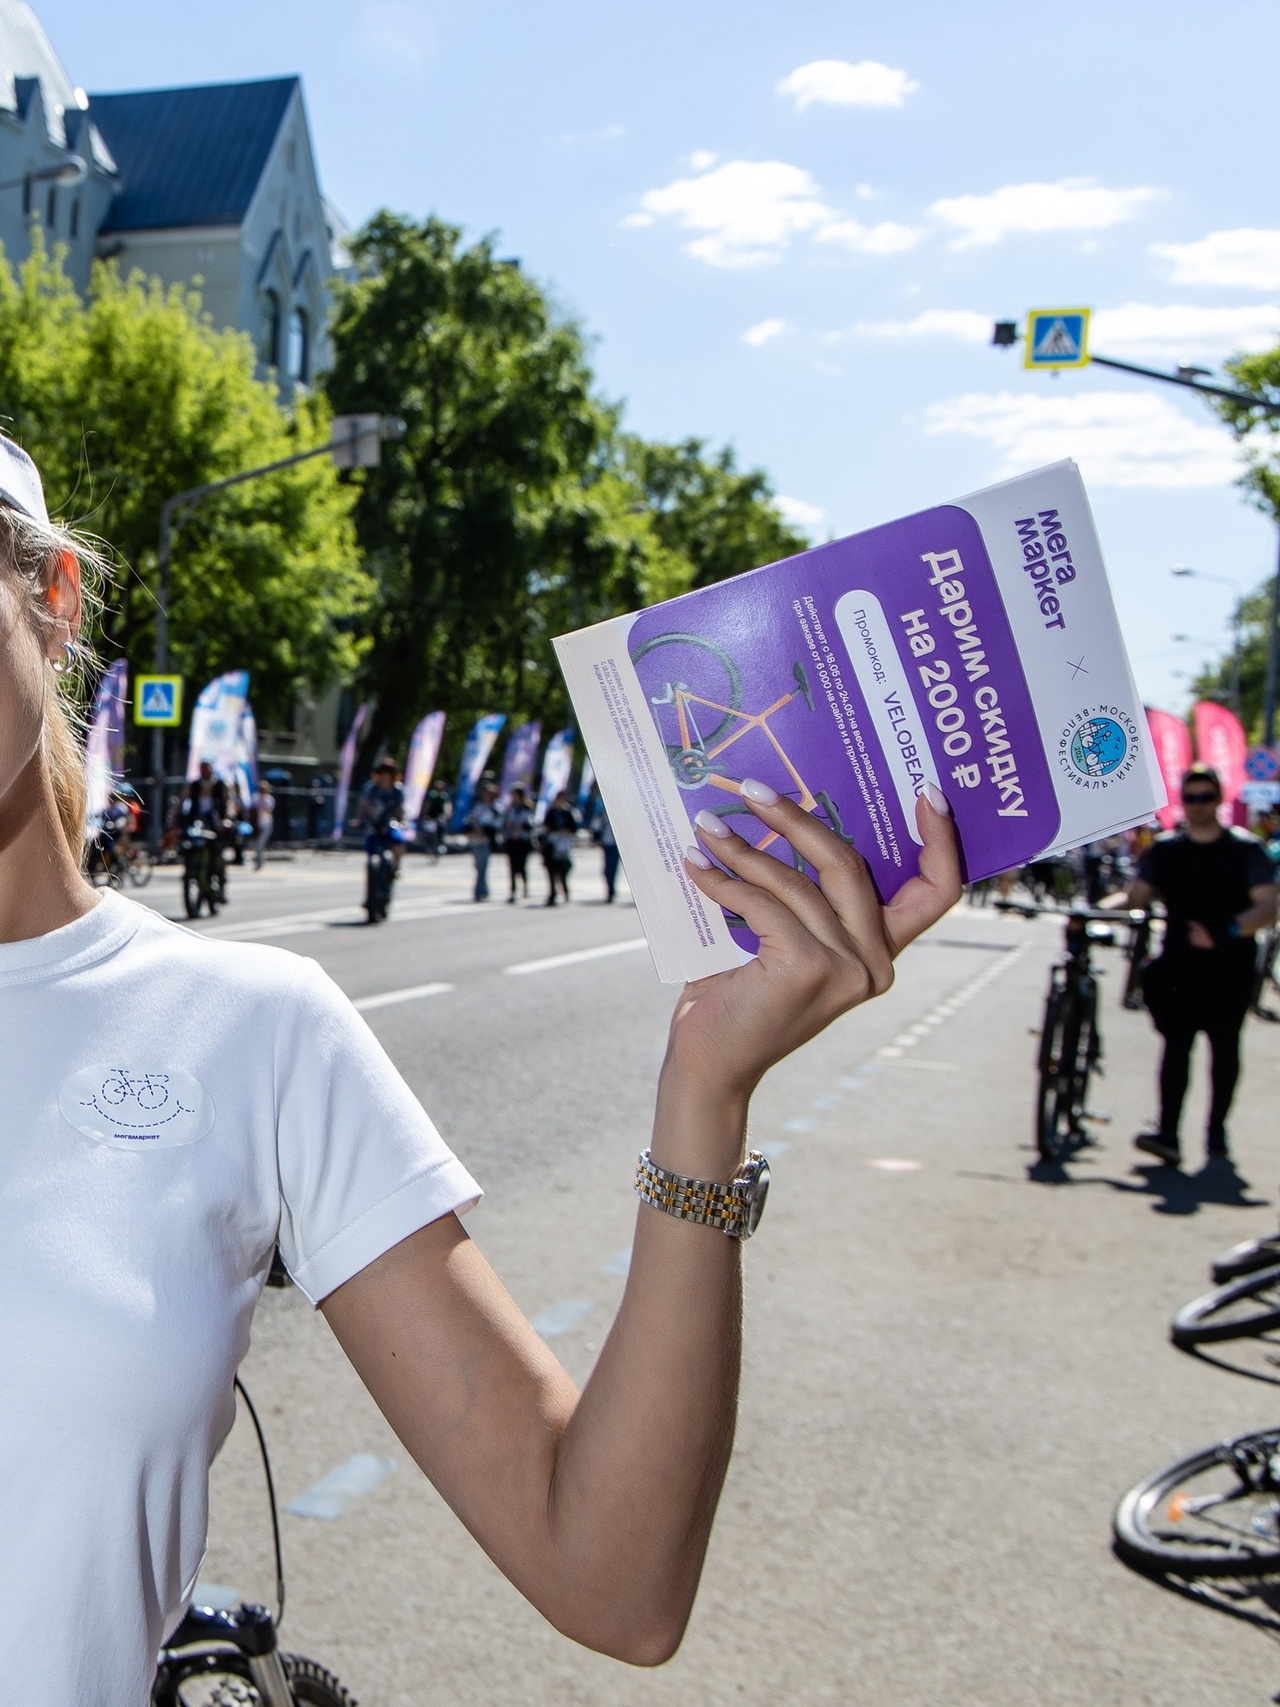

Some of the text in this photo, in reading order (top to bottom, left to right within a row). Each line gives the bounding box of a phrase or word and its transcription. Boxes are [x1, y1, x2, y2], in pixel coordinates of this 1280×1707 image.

[1037, 508, 1076, 585] мега
[1014, 518, 1067, 630] маркет
[790, 599, 804, 618] при
[802, 594, 827, 645] Действует
[798, 618, 816, 650] заказе
[853, 609, 887, 685] Промокод:
[810, 650, 820, 662] от
[814, 661, 824, 670] 6
[824, 652, 840, 677] 18.05
[817, 669, 831, 689] 000
[833, 677, 843, 690] по
[900, 609, 936, 657] на
[918, 659, 973, 757] 2000
[921, 548, 1028, 818] Дарим скидку
[824, 689, 834, 702] на
[838, 689, 855, 717] 24.05
[829, 702, 847, 730] сайте
[847, 717, 858, 730] на
[842, 737, 850, 745] в
[852, 729, 866, 752] весь
[1059, 709, 1108, 789] ВЕЛОФЕСТИВАЛЬ
[1100, 705, 1139, 781] МОСКОВСКИЙ
[1074, 747, 1084, 763] 2024
[844, 744, 872, 803] приложении
[859, 752, 879, 787] раздел
[872, 788, 894, 833] «Красота
[866, 803, 890, 861] Мегамаркет
[887, 832, 895, 840] и
[889, 840, 903, 868] уход»
[113, 1133, 160, 1141] мегамаркет
